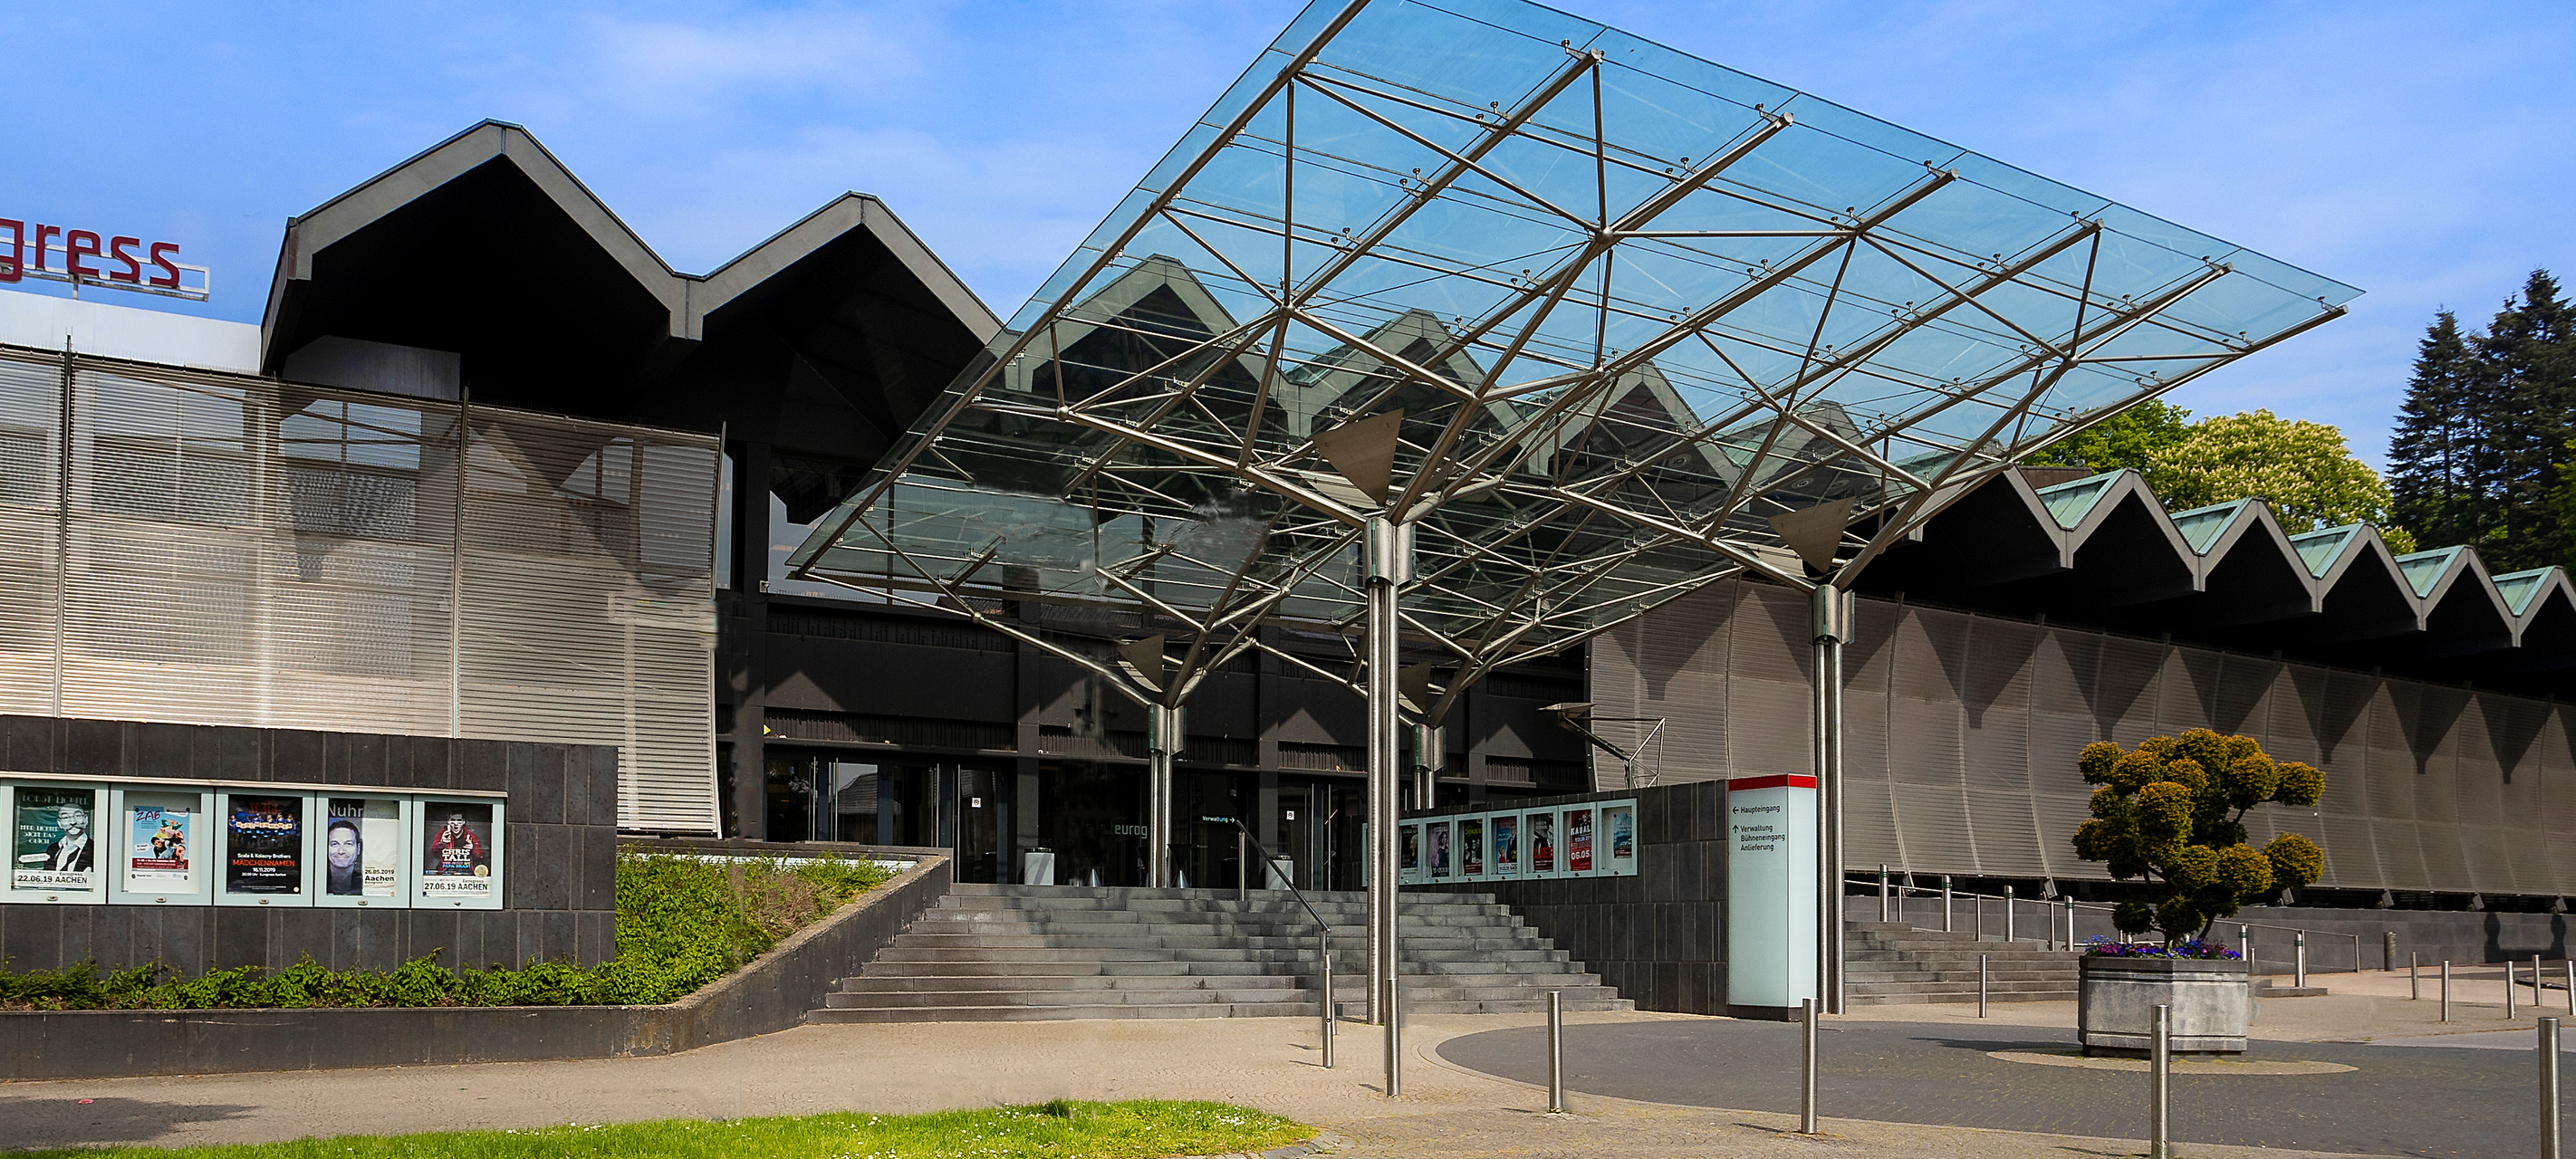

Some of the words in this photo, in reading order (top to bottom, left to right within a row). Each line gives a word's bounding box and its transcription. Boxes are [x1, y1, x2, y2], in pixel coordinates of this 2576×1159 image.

[329, 803, 363, 818] Nuhr
[1740, 805, 1781, 814] Haupteingang
[1202, 815, 1229, 824] Verwaltung
[1740, 825, 1773, 833] Verwaltung
[1740, 833, 1785, 842] Bühneneingang
[1740, 843, 1774, 852] Anlieferung
[232, 858, 295, 867] MÄDCHENNAMEN
[17, 875, 53, 883] 22.06.19
[54, 876, 87, 884] AACHEN
